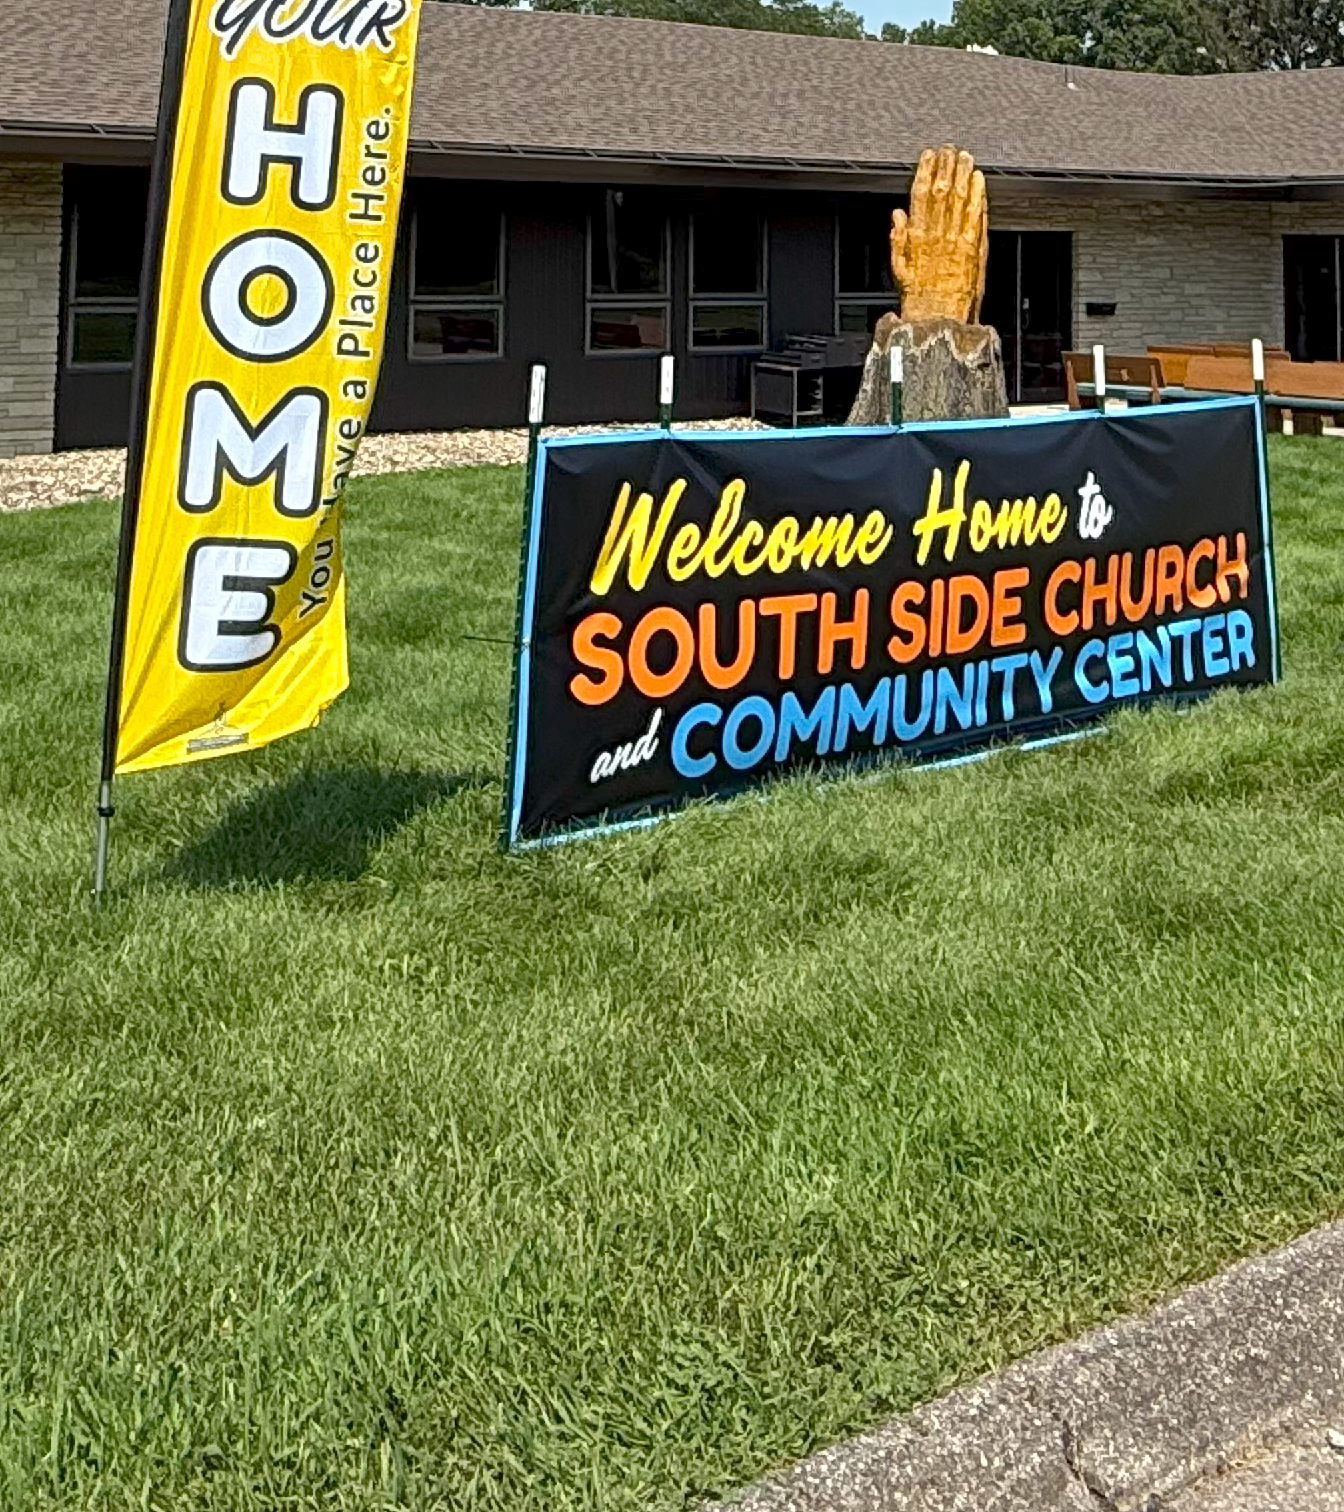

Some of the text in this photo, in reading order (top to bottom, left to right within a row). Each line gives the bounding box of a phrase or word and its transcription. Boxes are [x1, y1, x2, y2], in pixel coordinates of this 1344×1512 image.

[177, 76, 346, 673] HOME
[298, 107, 392, 619] You ave a Place Here.
[590, 459, 1113, 596] Welcome Home to
[569, 532, 1249, 707] SOUTH SIDE CHURCH
[588, 609, 1256, 785] and COMMUNITY CENTER
